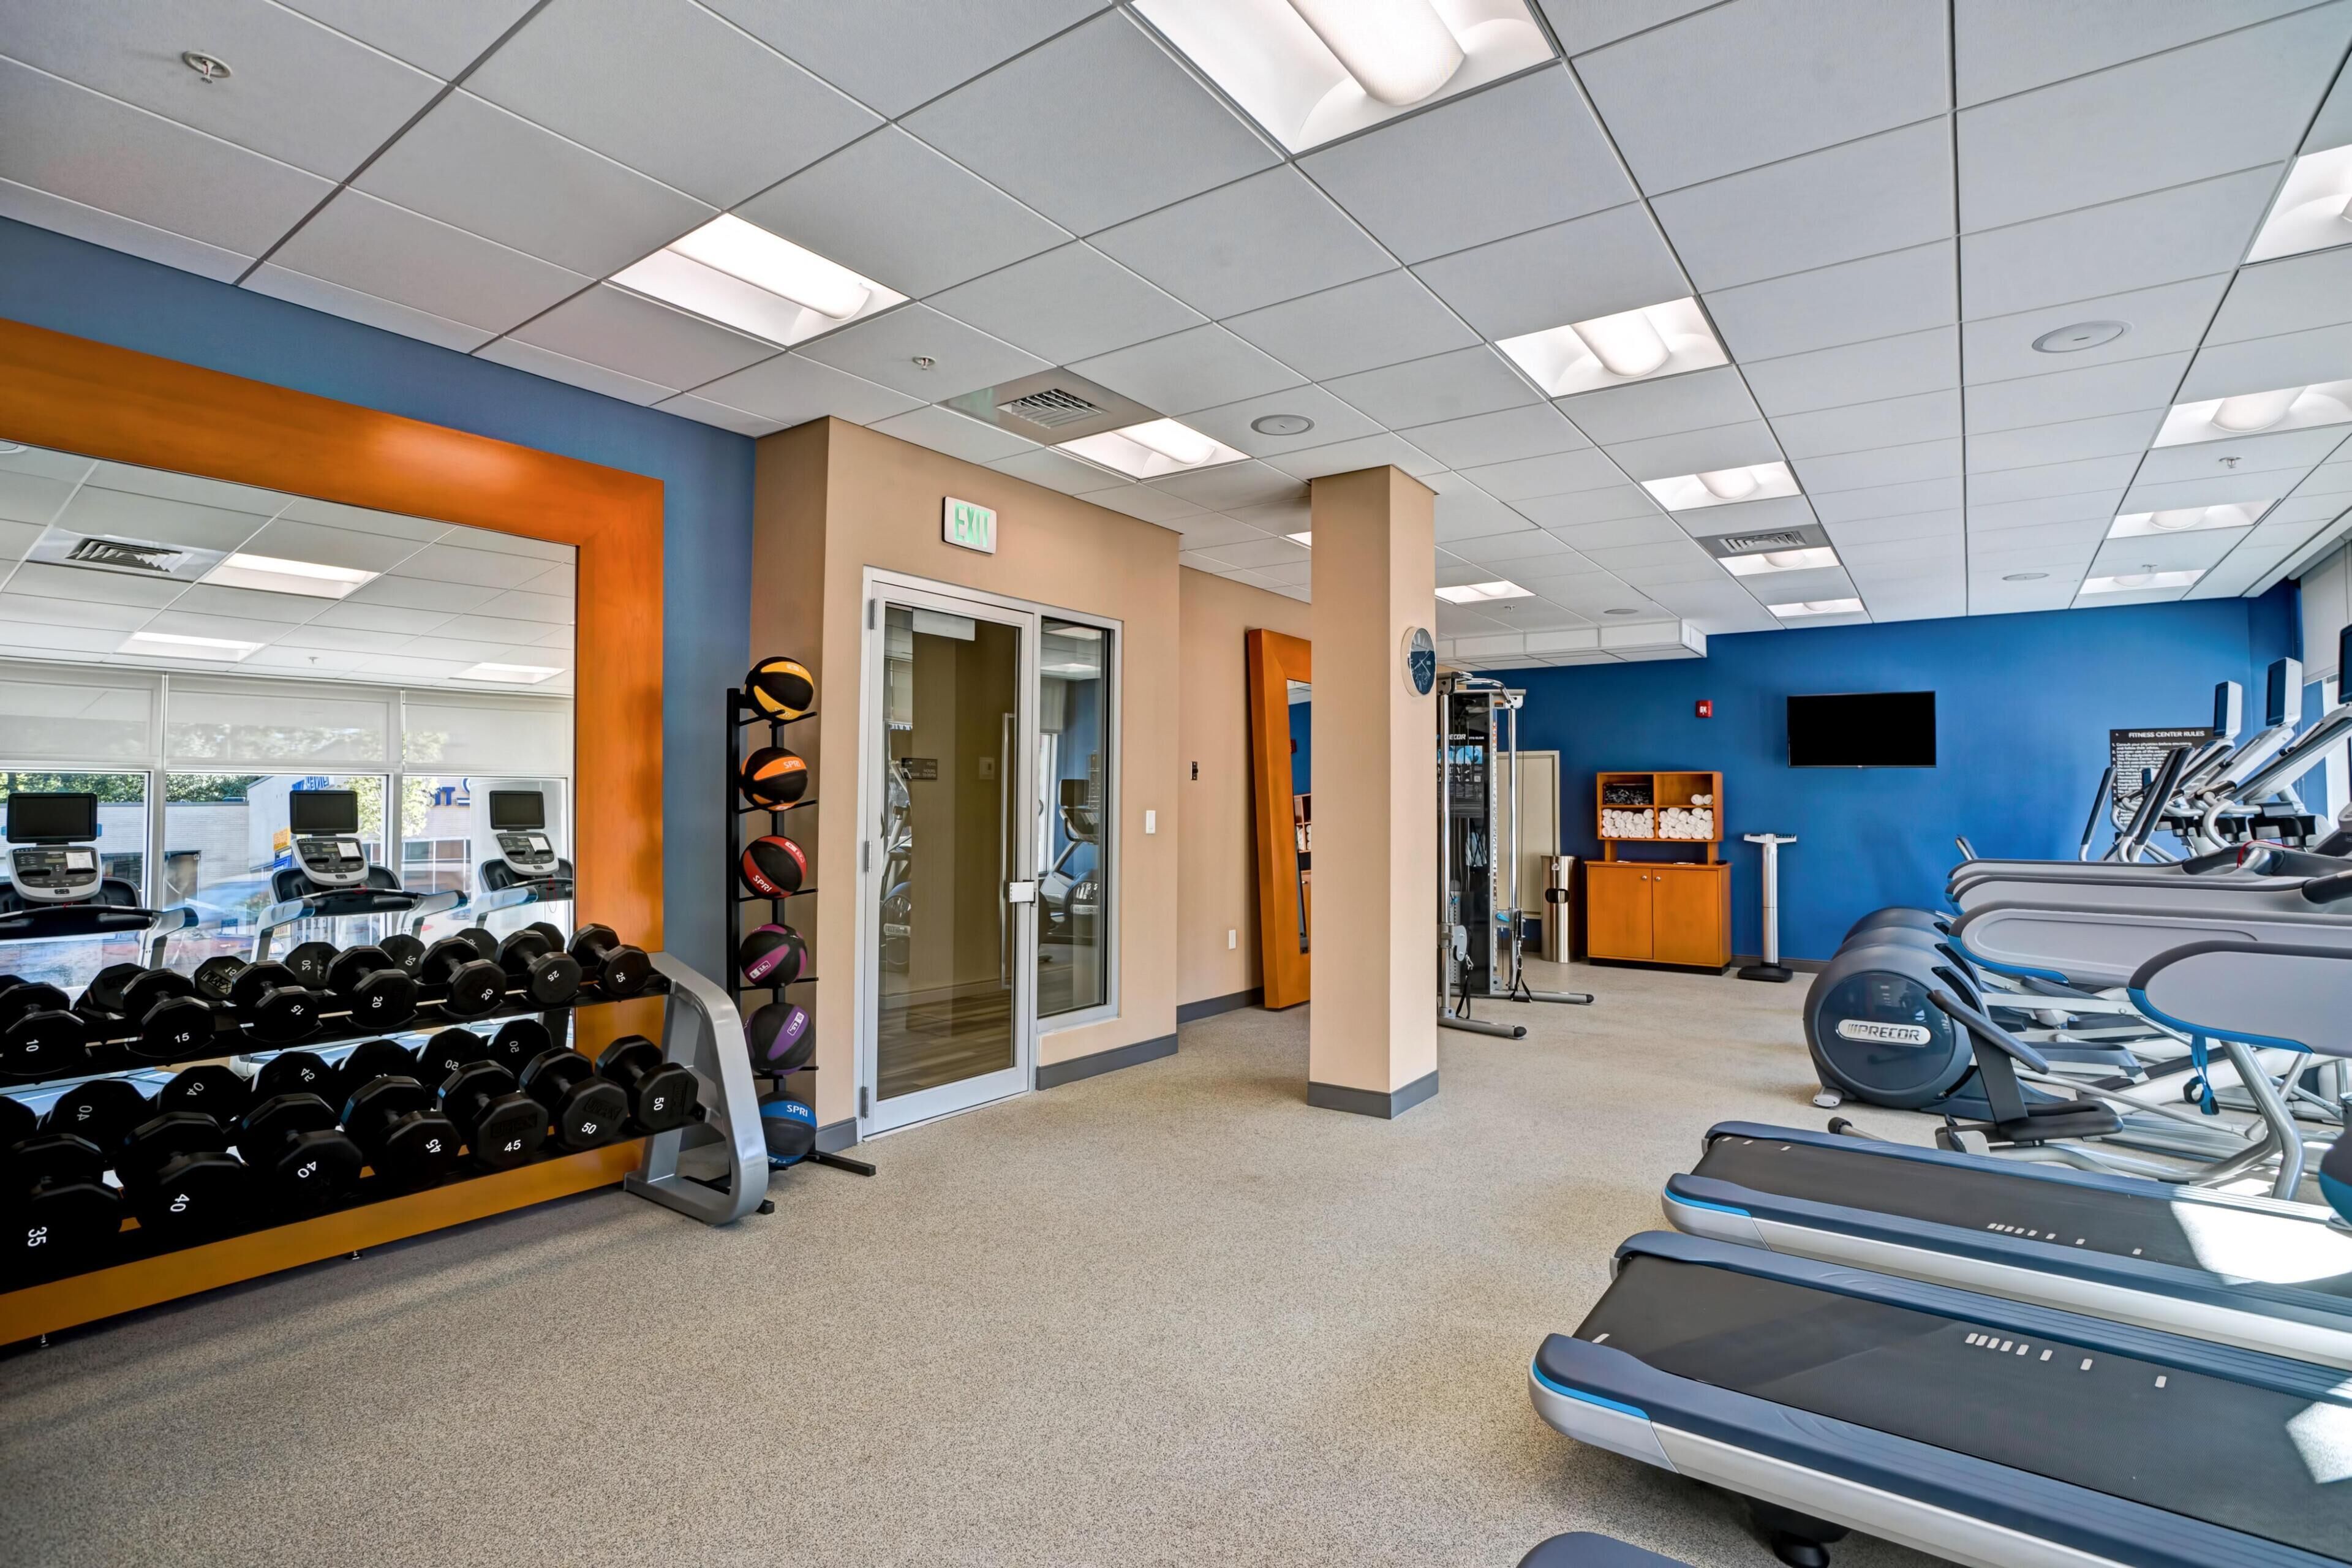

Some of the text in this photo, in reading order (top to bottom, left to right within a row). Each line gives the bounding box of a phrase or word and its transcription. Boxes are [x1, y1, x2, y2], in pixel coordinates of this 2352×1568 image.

[954, 502, 990, 548] EXIT
[783, 760, 801, 769] SPRI
[753, 875, 772, 892] SPRI
[547, 970, 560, 982] 25
[616, 972, 626, 983] 25
[481, 988, 494, 1001] 20
[372, 996, 383, 1009] 20
[290, 1005, 304, 1015] 15
[174, 1032, 190, 1043] 15
[1857, 1025, 1920, 1041] PRECOR
[26, 1039, 39, 1052] 10
[654, 1096, 665, 1111] 50
[786, 1104, 809, 1117] SPRI
[581, 1121, 597, 1134] 50
[426, 1139, 442, 1153] 45
[503, 1139, 522, 1152] 45
[297, 1161, 317, 1178] 40
[170, 1193, 190, 1212] 40
[27, 1226, 48, 1248] 35
